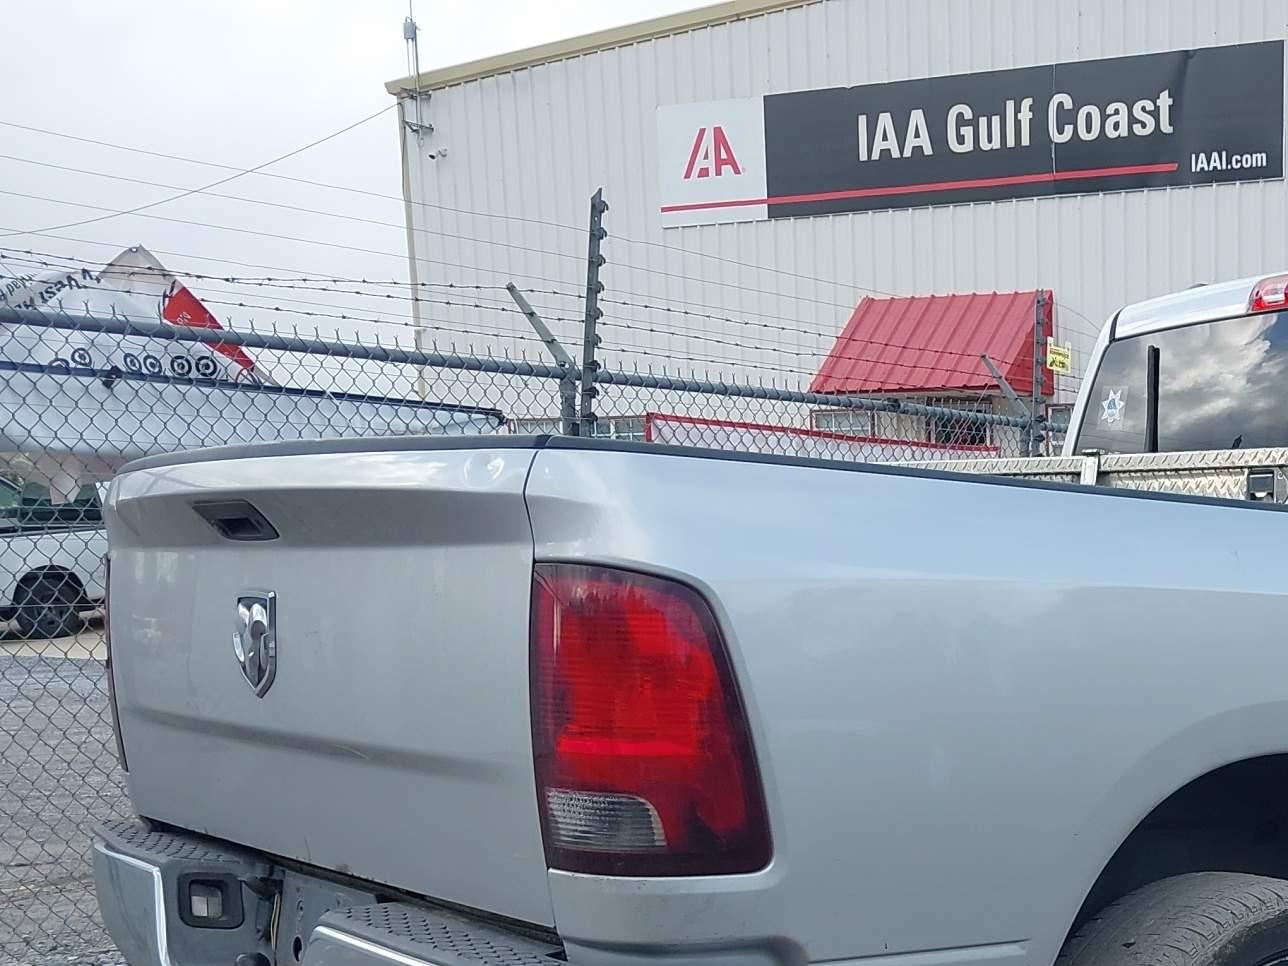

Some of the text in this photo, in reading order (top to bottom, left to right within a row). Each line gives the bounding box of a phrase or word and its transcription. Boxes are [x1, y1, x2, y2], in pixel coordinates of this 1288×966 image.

[857, 89, 1174, 162] IAA Gulf Coast
[1191, 150, 1267, 172] IAAI.com
